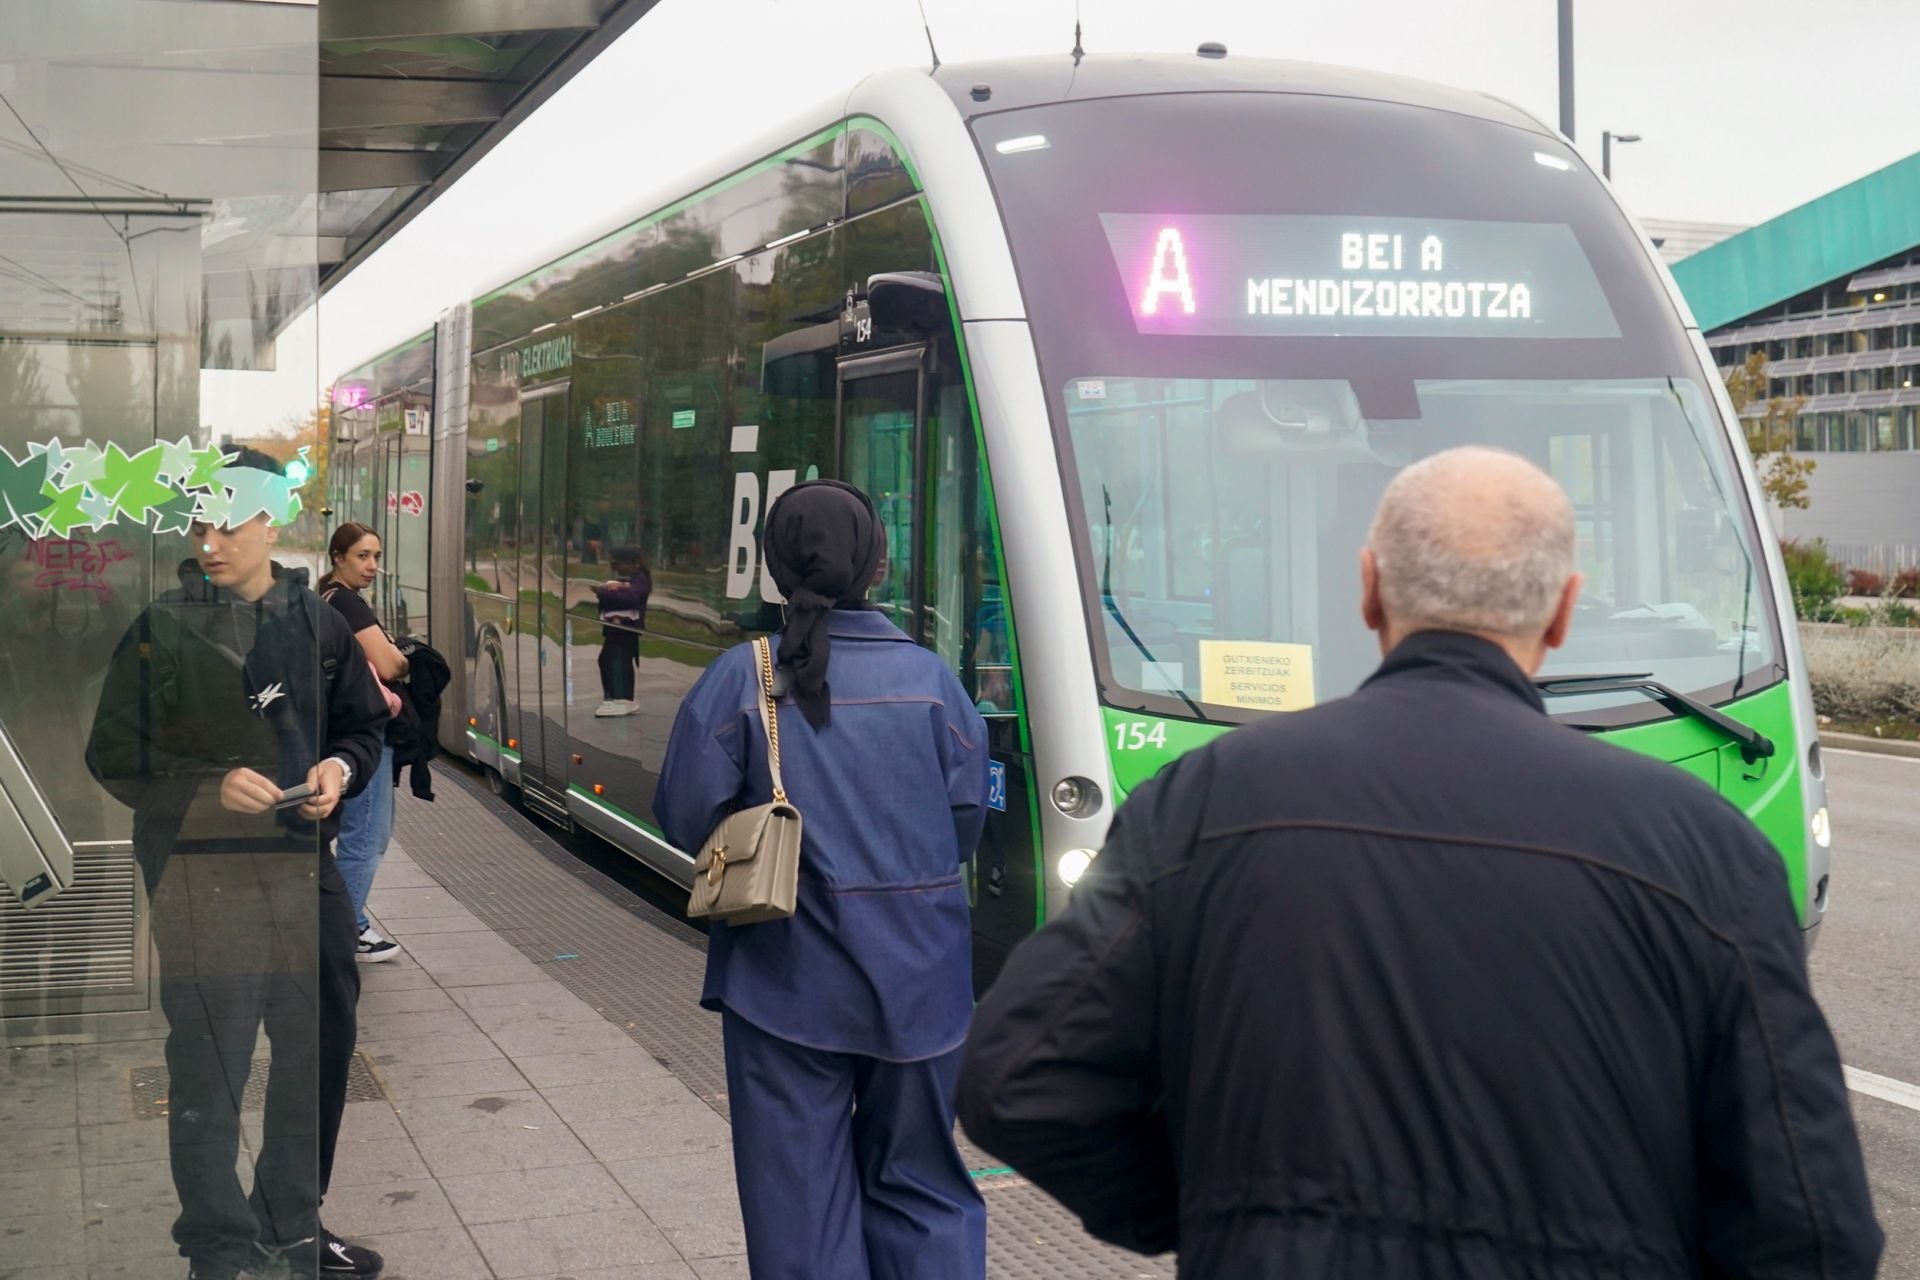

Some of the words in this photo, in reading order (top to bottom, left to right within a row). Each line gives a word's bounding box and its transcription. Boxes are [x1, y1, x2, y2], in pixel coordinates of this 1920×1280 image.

[1342, 233, 1402, 271] BEI
[1421, 235, 1443, 271] A
[1140, 226, 1197, 317] A
[1247, 278, 1531, 319] MENDIZORROTZA
[856, 317, 872, 343] 154
[522, 334, 573, 377] ELEKTRIKOA
[1223, 655, 1290, 666] GUTXIENEKO
[1224, 666, 1290, 677] ZERBITZUAK
[1230, 682, 1286, 692] SERVICIOS
[1236, 695, 1281, 705] MINIMOS
[1114, 721, 1167, 751] 154
